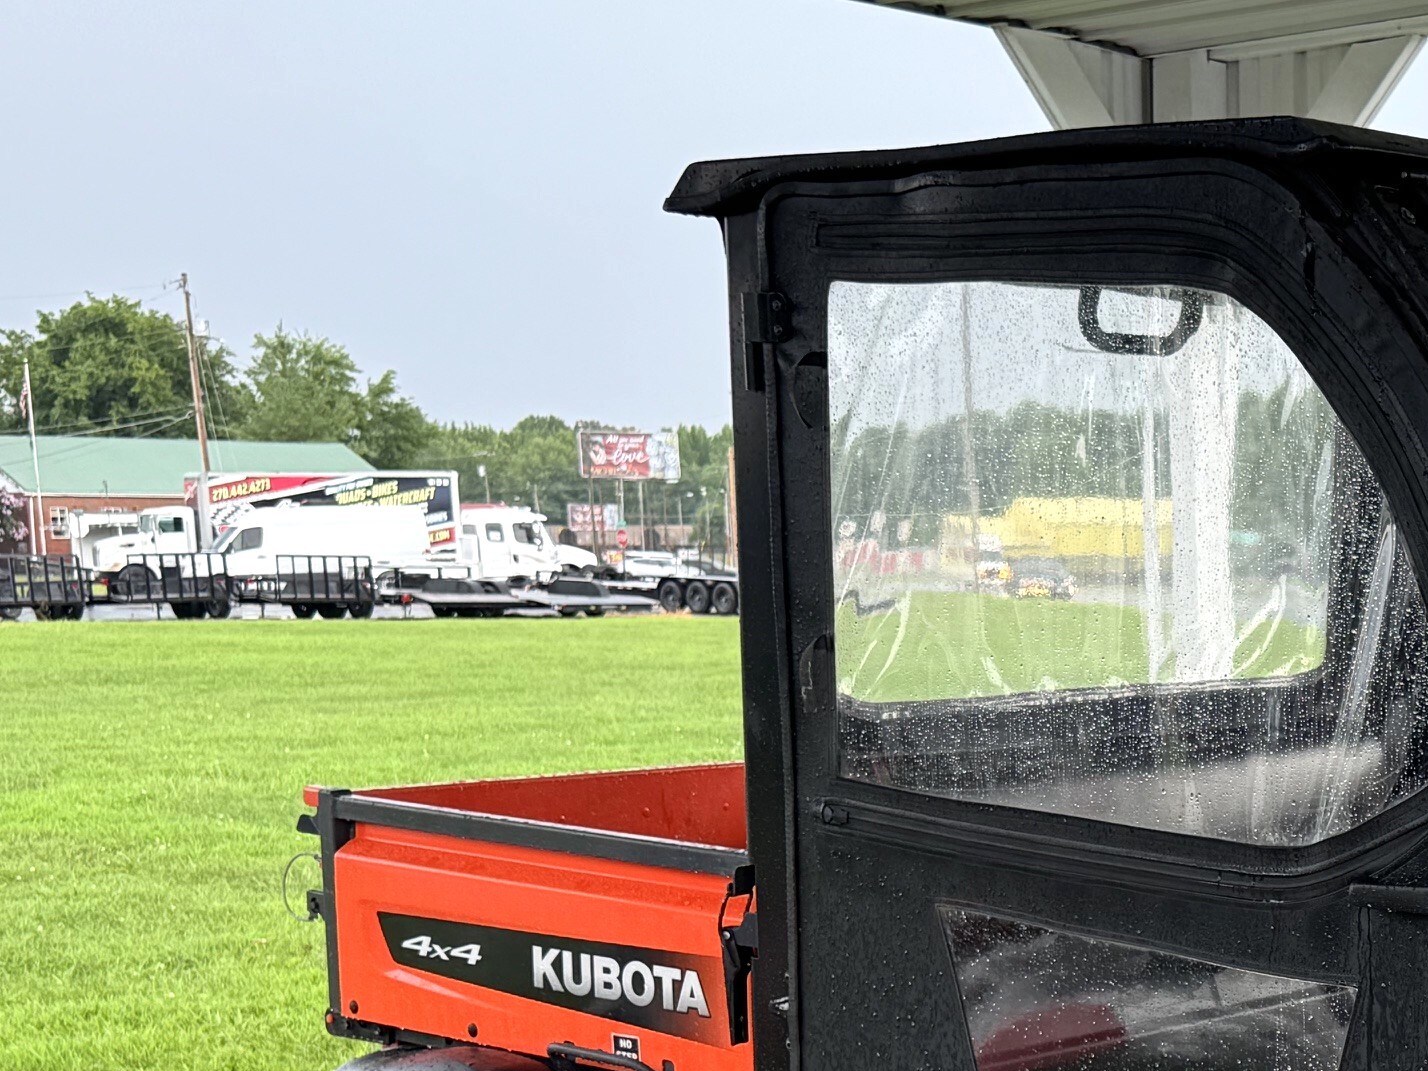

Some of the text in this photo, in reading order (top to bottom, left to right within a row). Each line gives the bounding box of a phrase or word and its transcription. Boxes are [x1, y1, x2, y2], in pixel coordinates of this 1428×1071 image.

[371, 480, 398, 498] BIKES
[379, 487, 436, 506] WATERCRAFT
[401, 935, 483, 966] 4x4
[531, 944, 711, 1018] KUBOTA
[618, 1038, 633, 1050] NO
